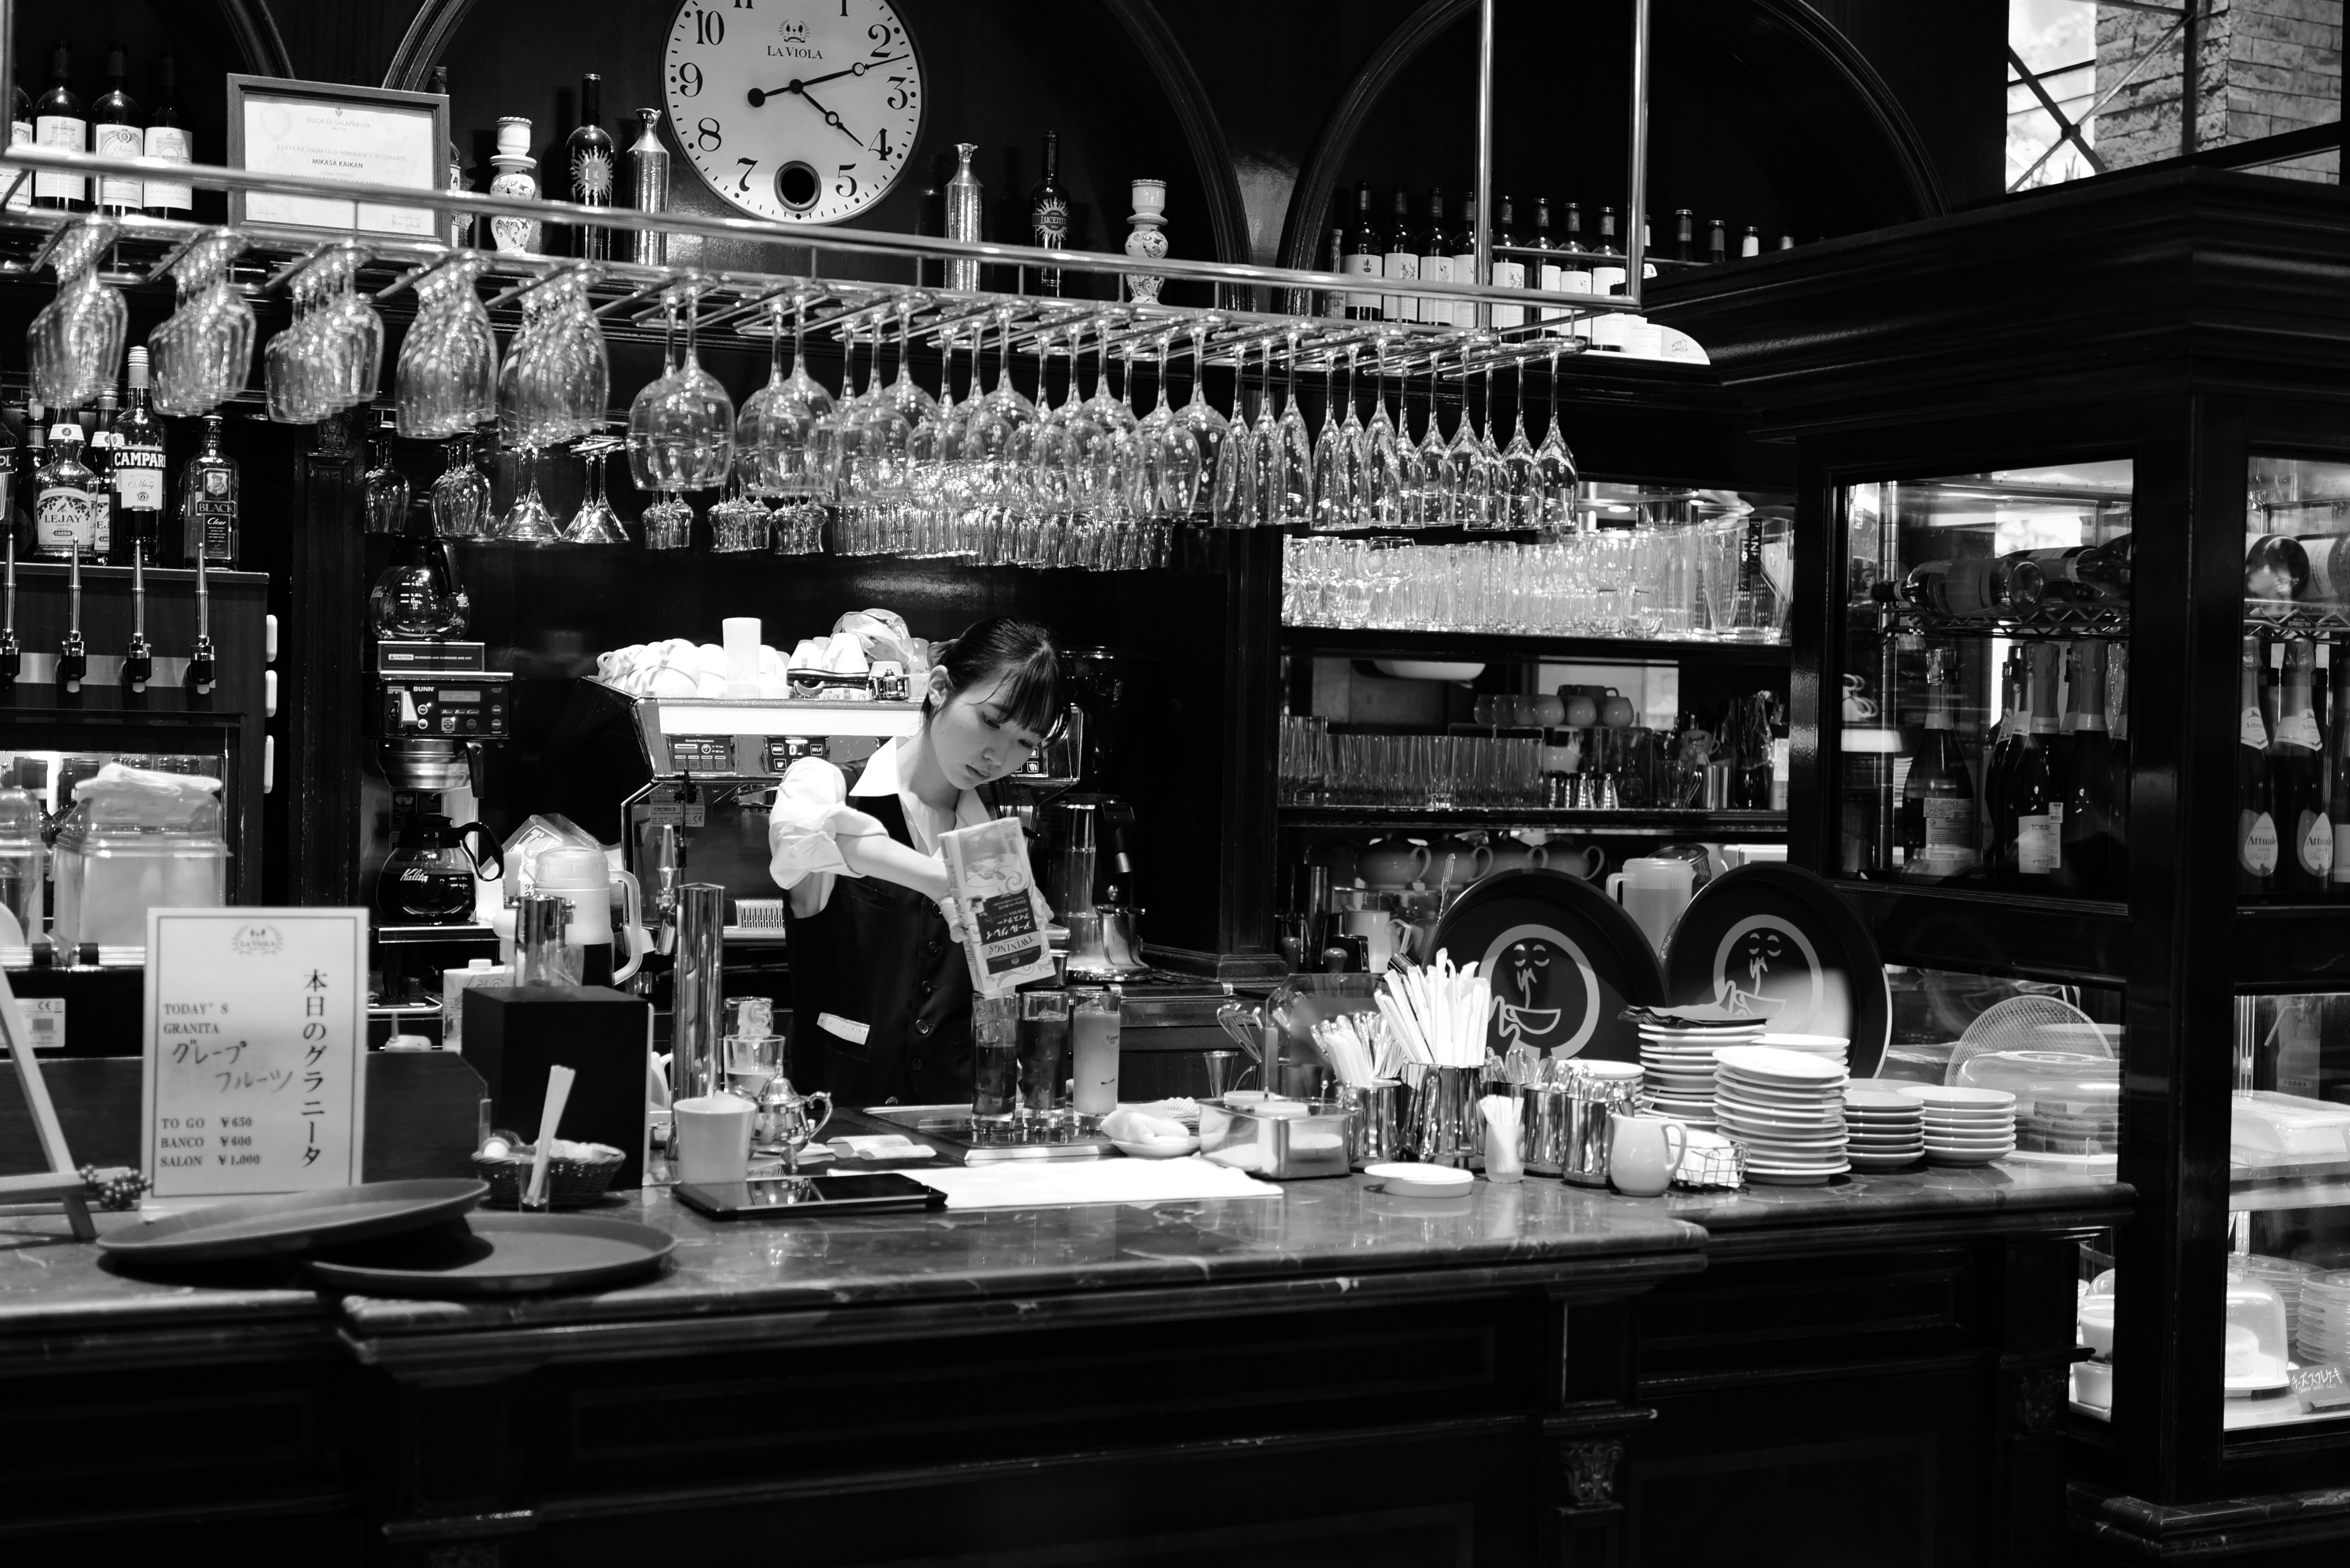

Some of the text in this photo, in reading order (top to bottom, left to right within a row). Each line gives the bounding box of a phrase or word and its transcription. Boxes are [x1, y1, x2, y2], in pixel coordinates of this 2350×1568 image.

[696, 10, 724, 45] 10
[868, 24, 891, 58] 2
[767, 46, 823, 59] LA VIOLA
[679, 63, 702, 97] 9
[887, 76, 908, 109] 3
[334, 120, 371, 129] SALAPARUTA
[698, 118, 721, 151] 8
[868, 128, 892, 160] 4
[339, 160, 363, 168] KAIKAN
[375, 153, 406, 161] RISTORANTE
[736, 157, 758, 191] 7
[836, 163, 856, 197] 5
[1041, 216, 1067, 225] LUCENTE
[114, 452, 166, 467] CAMPARI
[199, 503, 234, 512] BLACK
[45, 515, 81, 523] LEJAY
[207, 517, 226, 525] Clear
[400, 868, 428, 882] Kalita
[997, 912, 1030, 924] アイスティー
[989, 935, 1034, 953] TWININGS
[163, 1023, 220, 1034] GRANITA
[172, 1040, 248, 1065] グレープ
[302, 968, 328, 1168] 本日のグラニータ
[215, 1070, 294, 1094] フルーツ
[161, 1118, 179, 1129] TO
[186, 1118, 205, 1129] GO
[161, 1137, 205, 1148] BANCO
[160, 1156, 203, 1167] SALON
